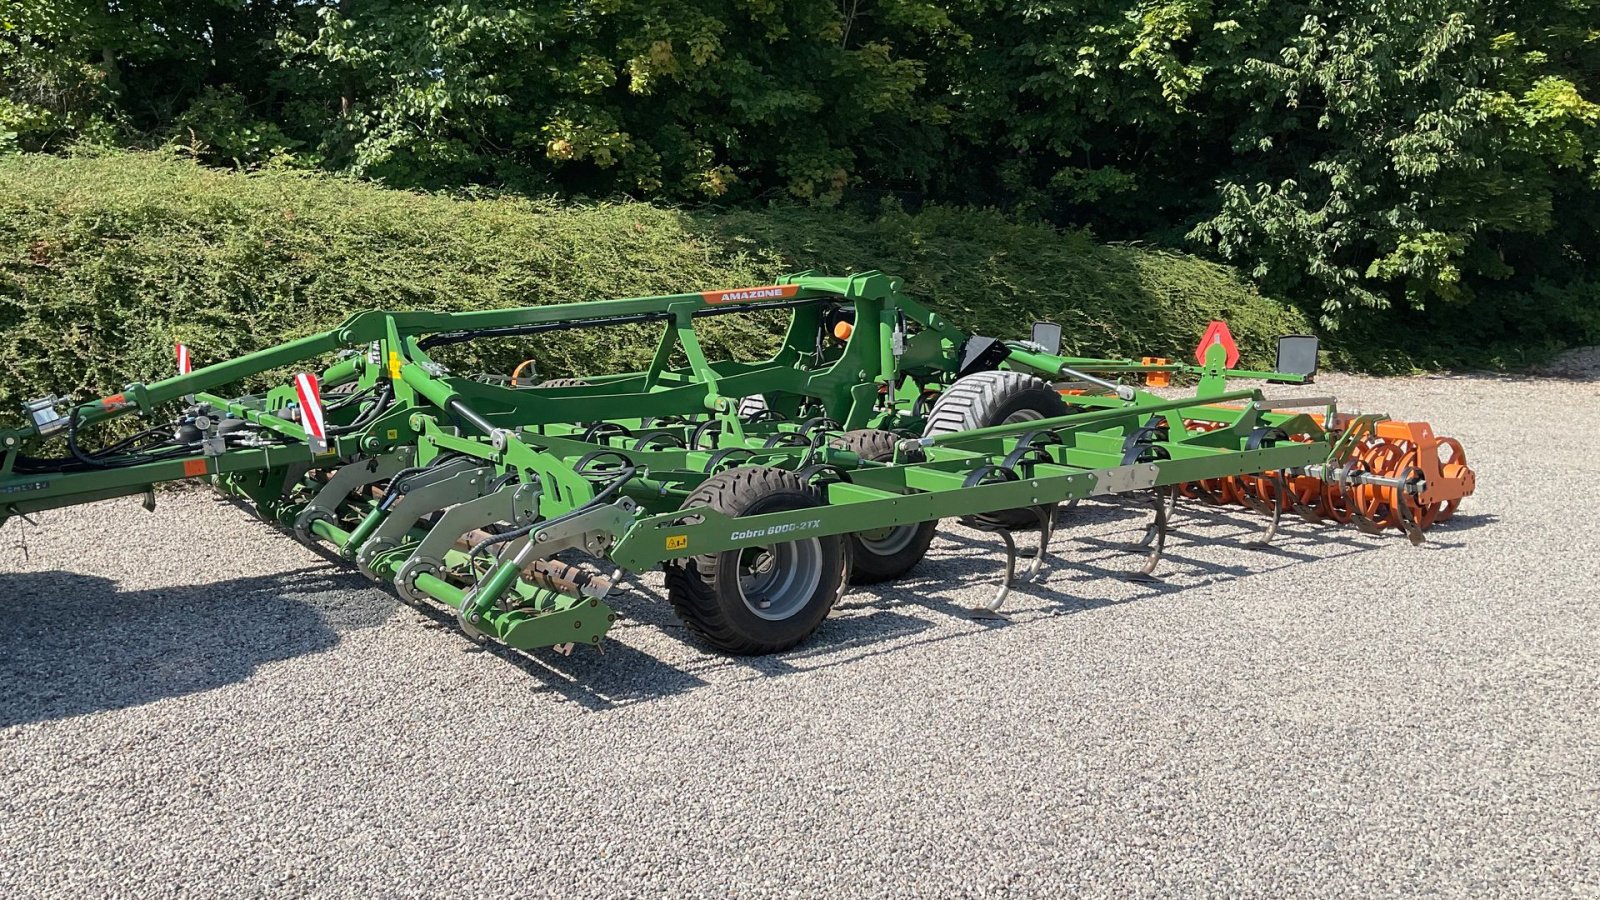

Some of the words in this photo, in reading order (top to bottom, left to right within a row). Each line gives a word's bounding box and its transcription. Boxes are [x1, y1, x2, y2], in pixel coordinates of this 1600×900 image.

[721, 289, 783, 301] AMAZONE
[731, 530, 765, 541] Cobra
[767, 520, 821, 535] 6000-2TX
